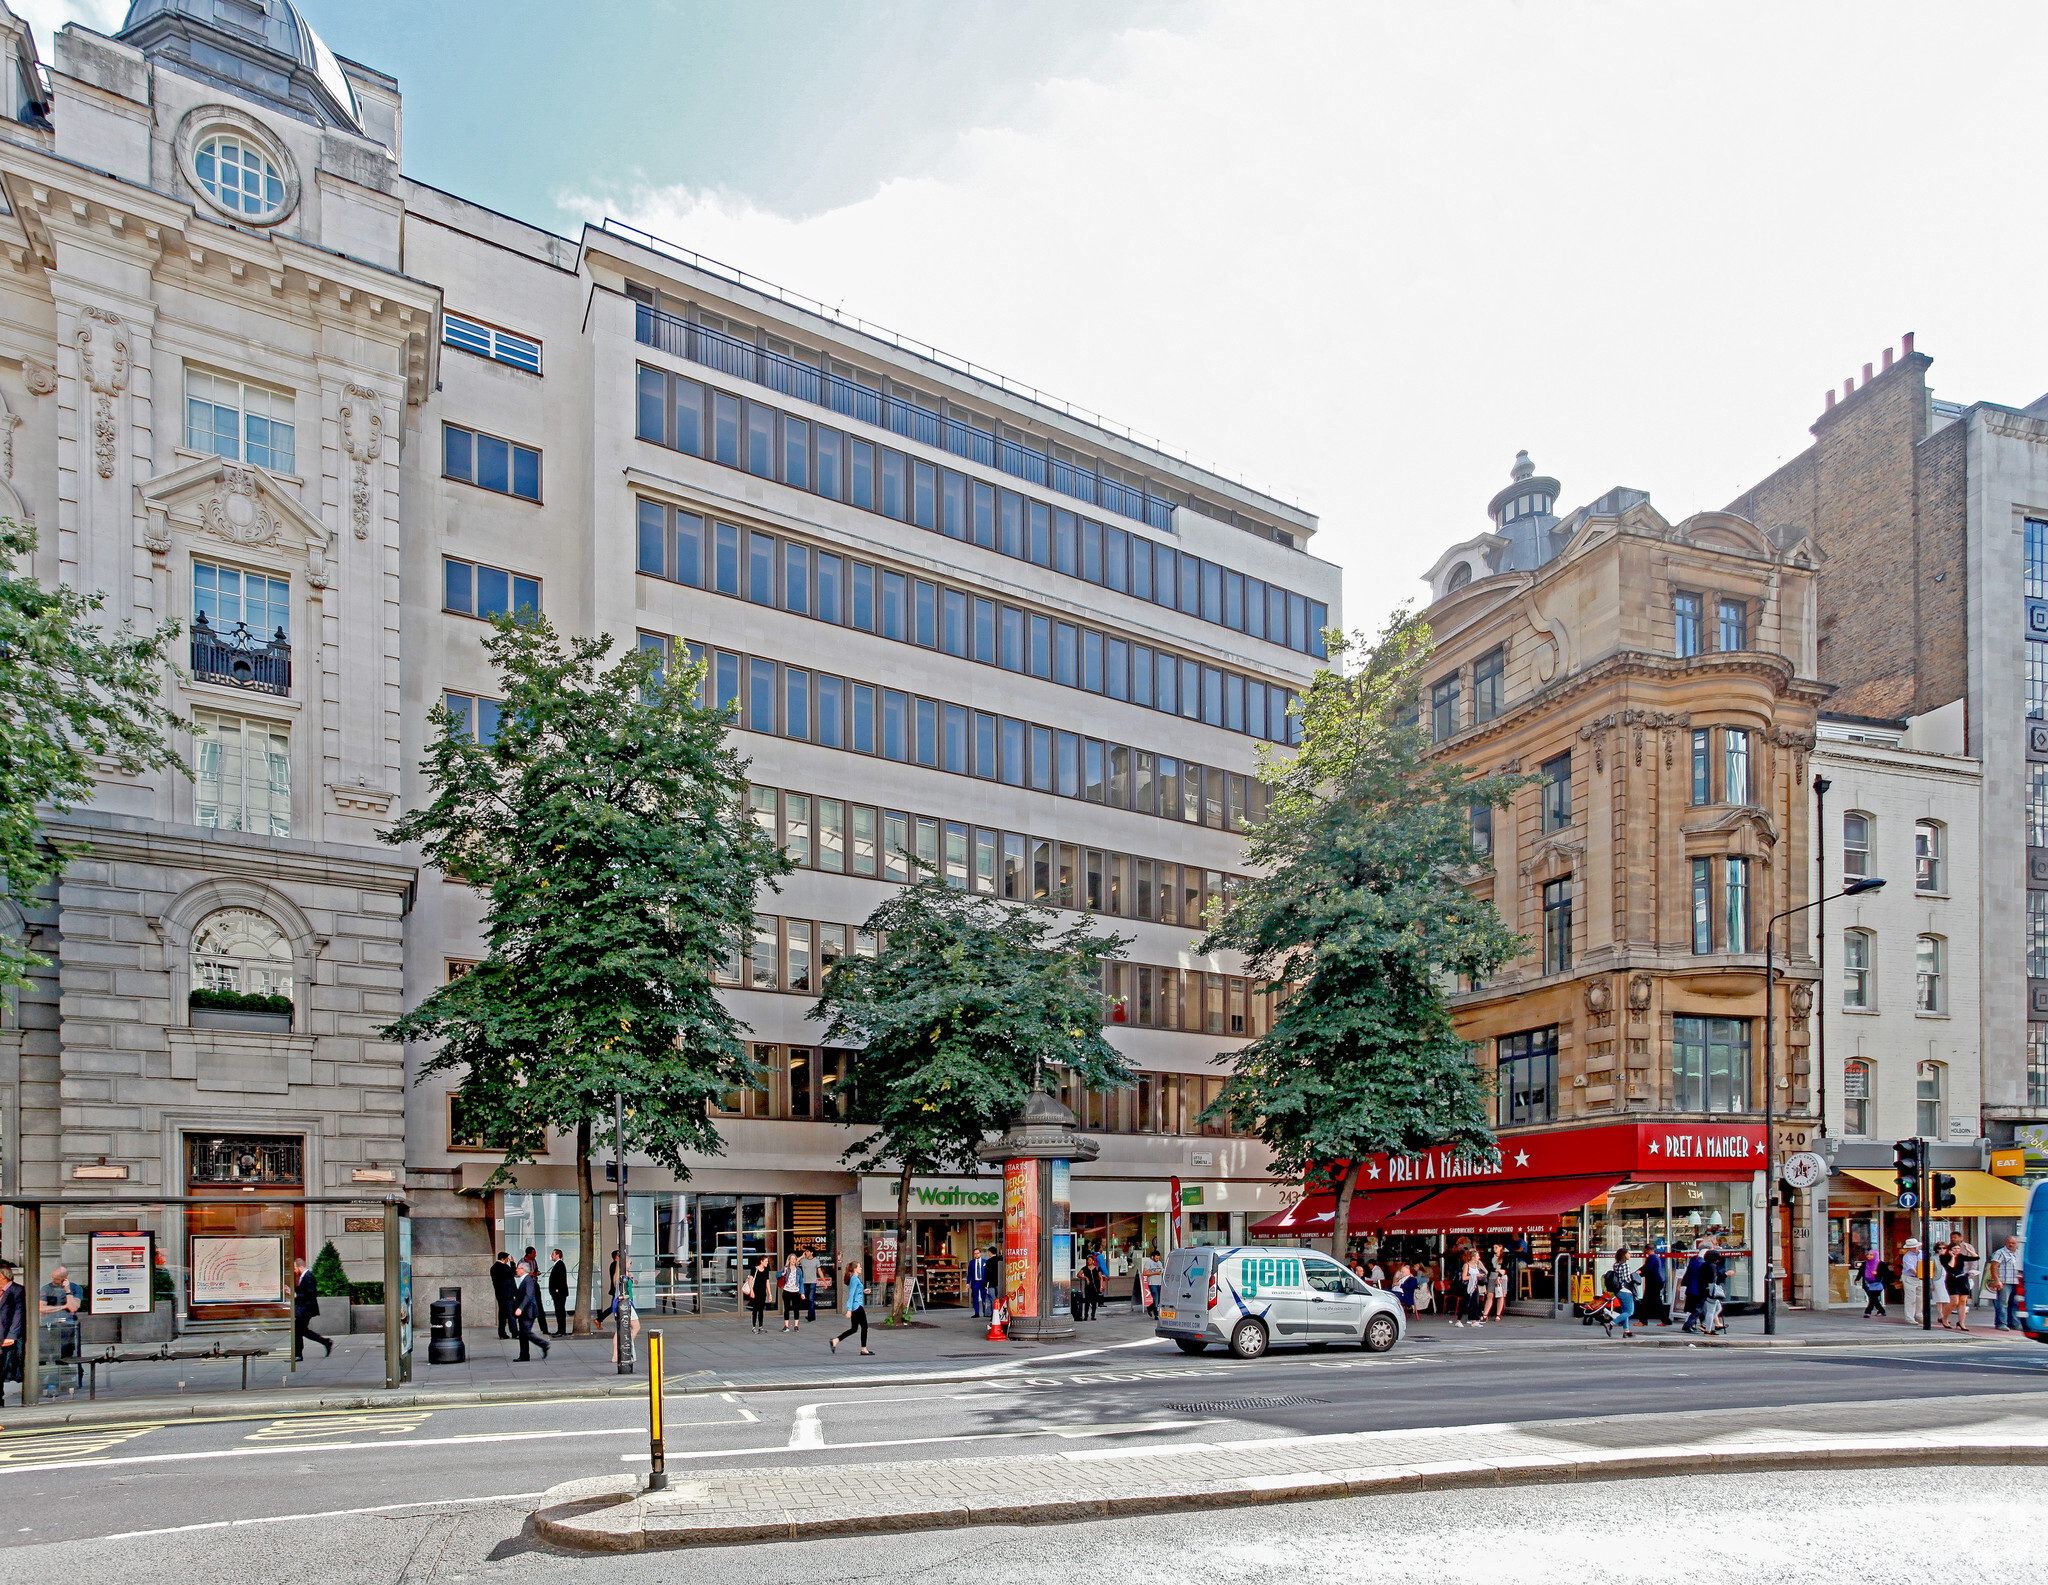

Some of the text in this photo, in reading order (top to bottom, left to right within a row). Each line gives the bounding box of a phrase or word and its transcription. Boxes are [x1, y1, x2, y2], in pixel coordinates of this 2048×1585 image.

[1665, 1135, 1750, 1158] PRET A MANGER
[1007, 1161, 1028, 1171] STARTS
[1389, 1154, 1420, 1183] PRET
[1425, 1152, 1436, 1180] A
[1996, 1159, 2019, 1167] EAT.
[917, 1185, 1000, 1206] Waitrose
[1279, 1191, 1298, 1205] 243
[1793, 1228, 1810, 1239] 240
[793, 1236, 827, 1244] WESTON
[876, 1240, 898, 1251] 25%
[876, 1251, 898, 1262] OFF
[1007, 1248, 1028, 1256] STARTS
[1242, 1258, 1300, 1298] gem
[983, 1368, 1235, 1389] LOADING
